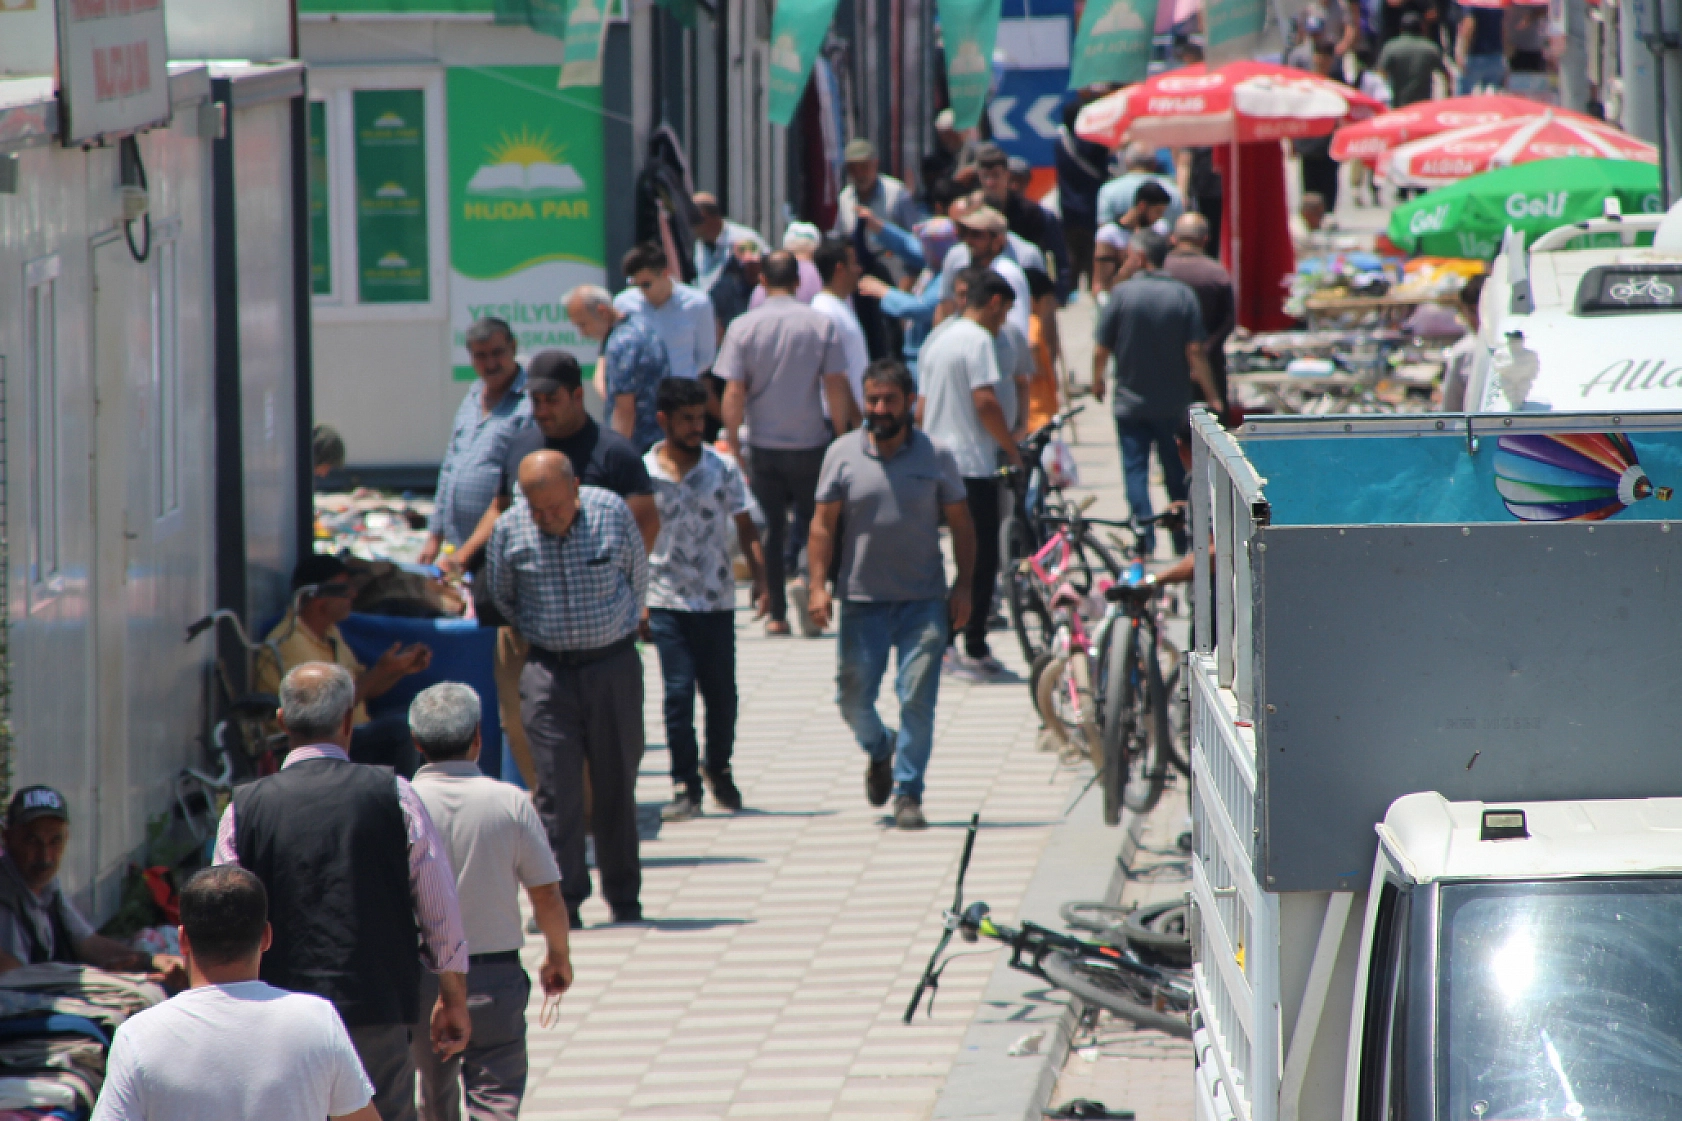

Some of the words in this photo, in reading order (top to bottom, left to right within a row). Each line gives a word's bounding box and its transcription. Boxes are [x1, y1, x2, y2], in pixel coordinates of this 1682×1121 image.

[541, 201, 589, 220] PAR
[1410, 203, 1449, 234] Golf
[1505, 190, 1568, 219] Golf
